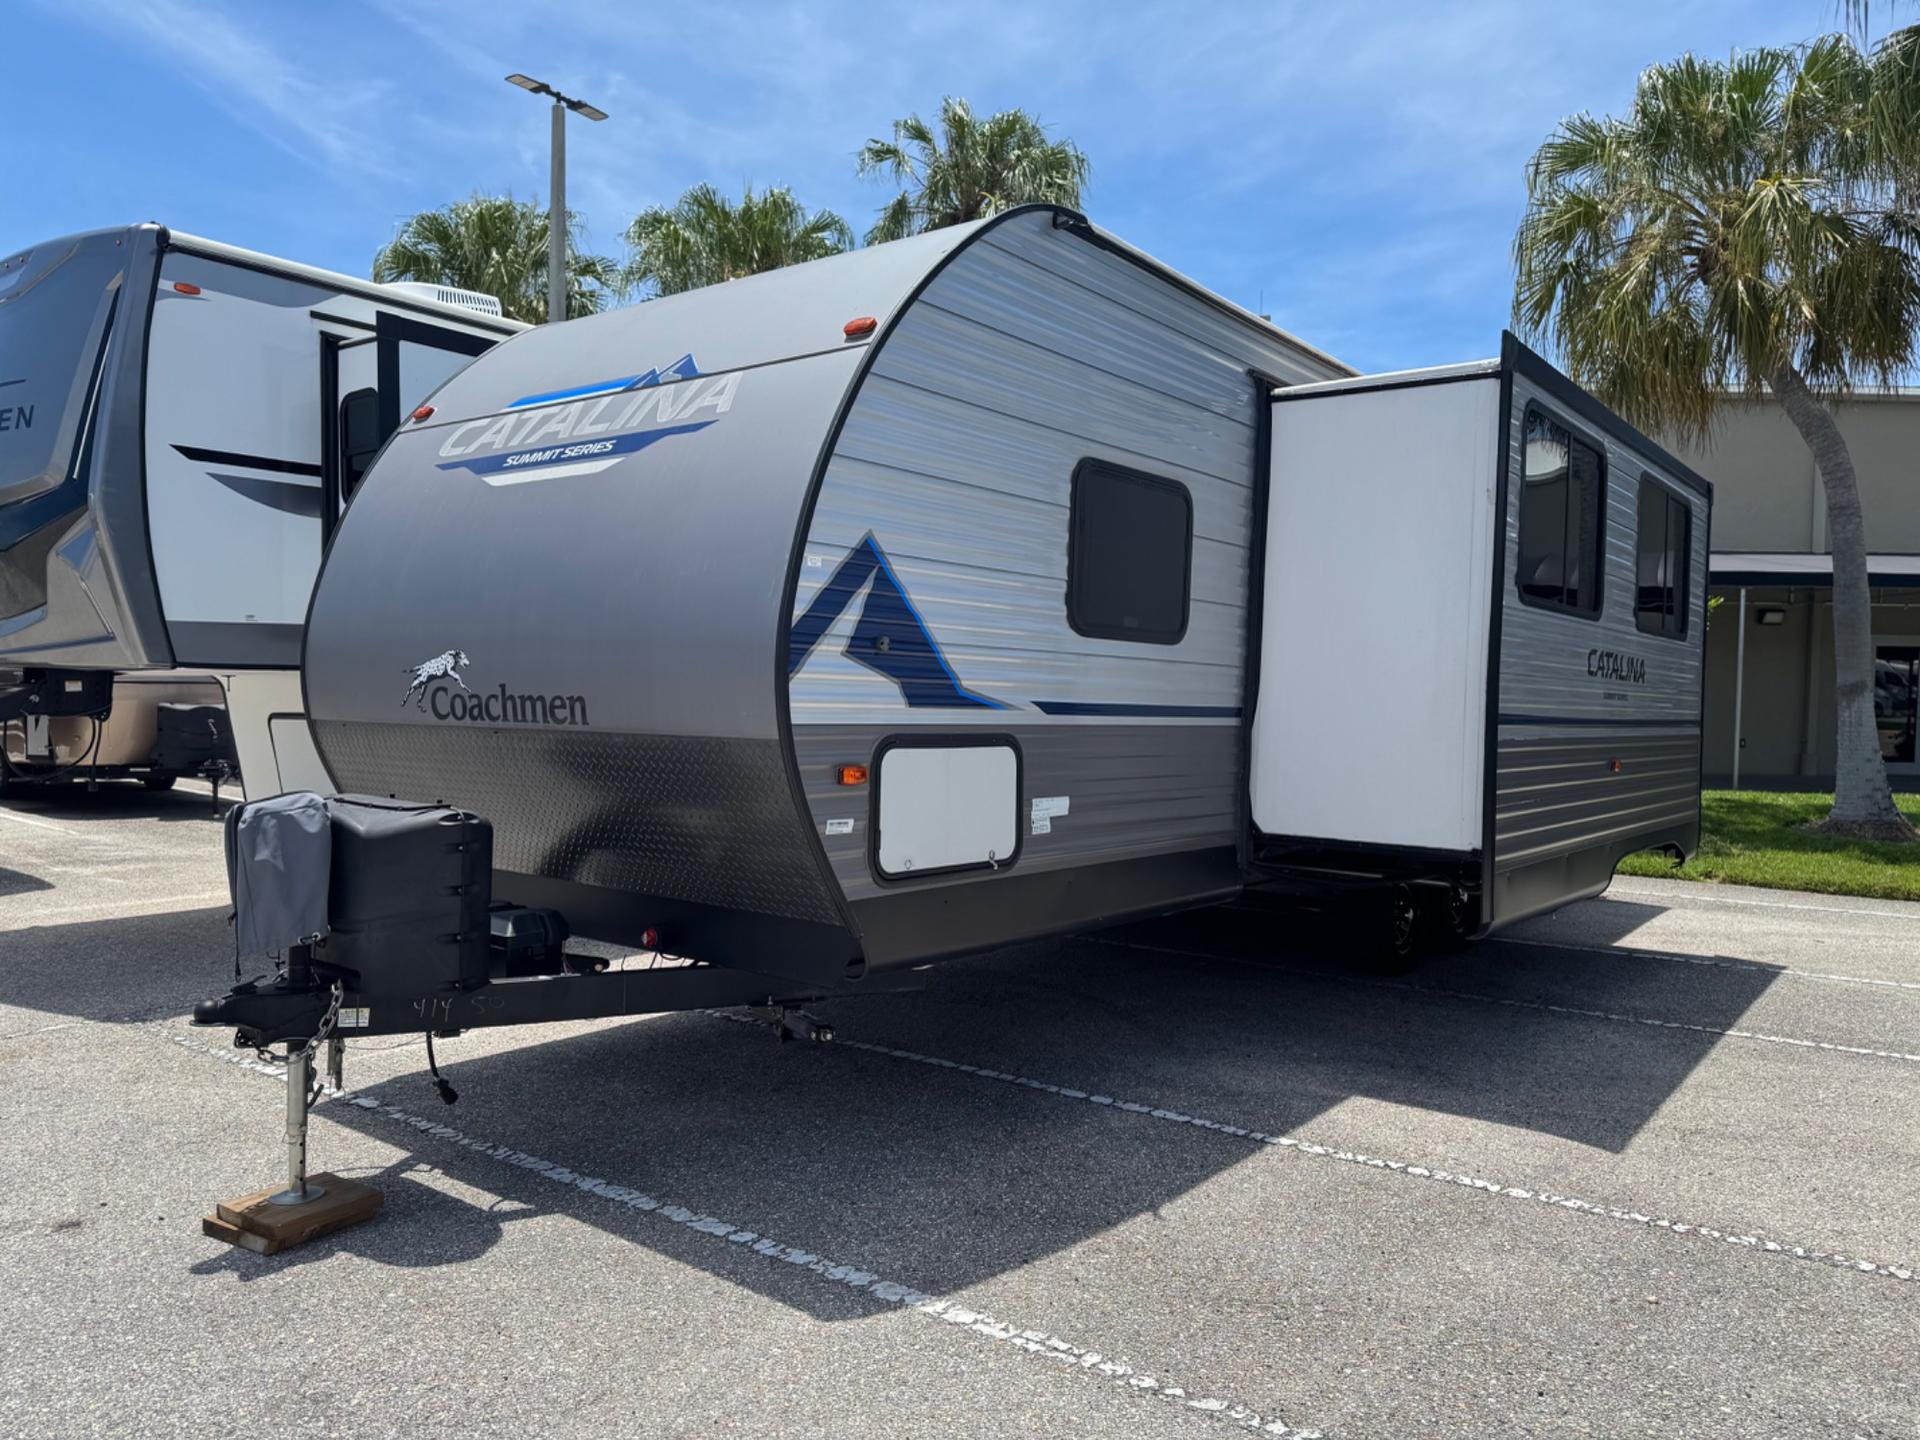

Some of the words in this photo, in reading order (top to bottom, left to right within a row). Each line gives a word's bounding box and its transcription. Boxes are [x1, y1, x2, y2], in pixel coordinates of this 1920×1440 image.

[438, 370, 744, 457] CATALINA
[502, 448, 564, 467] SUMMIT
[560, 440, 617, 458] SERIES
[1587, 648, 1646, 684] CATALINA
[430, 683, 590, 726] Coachmen
